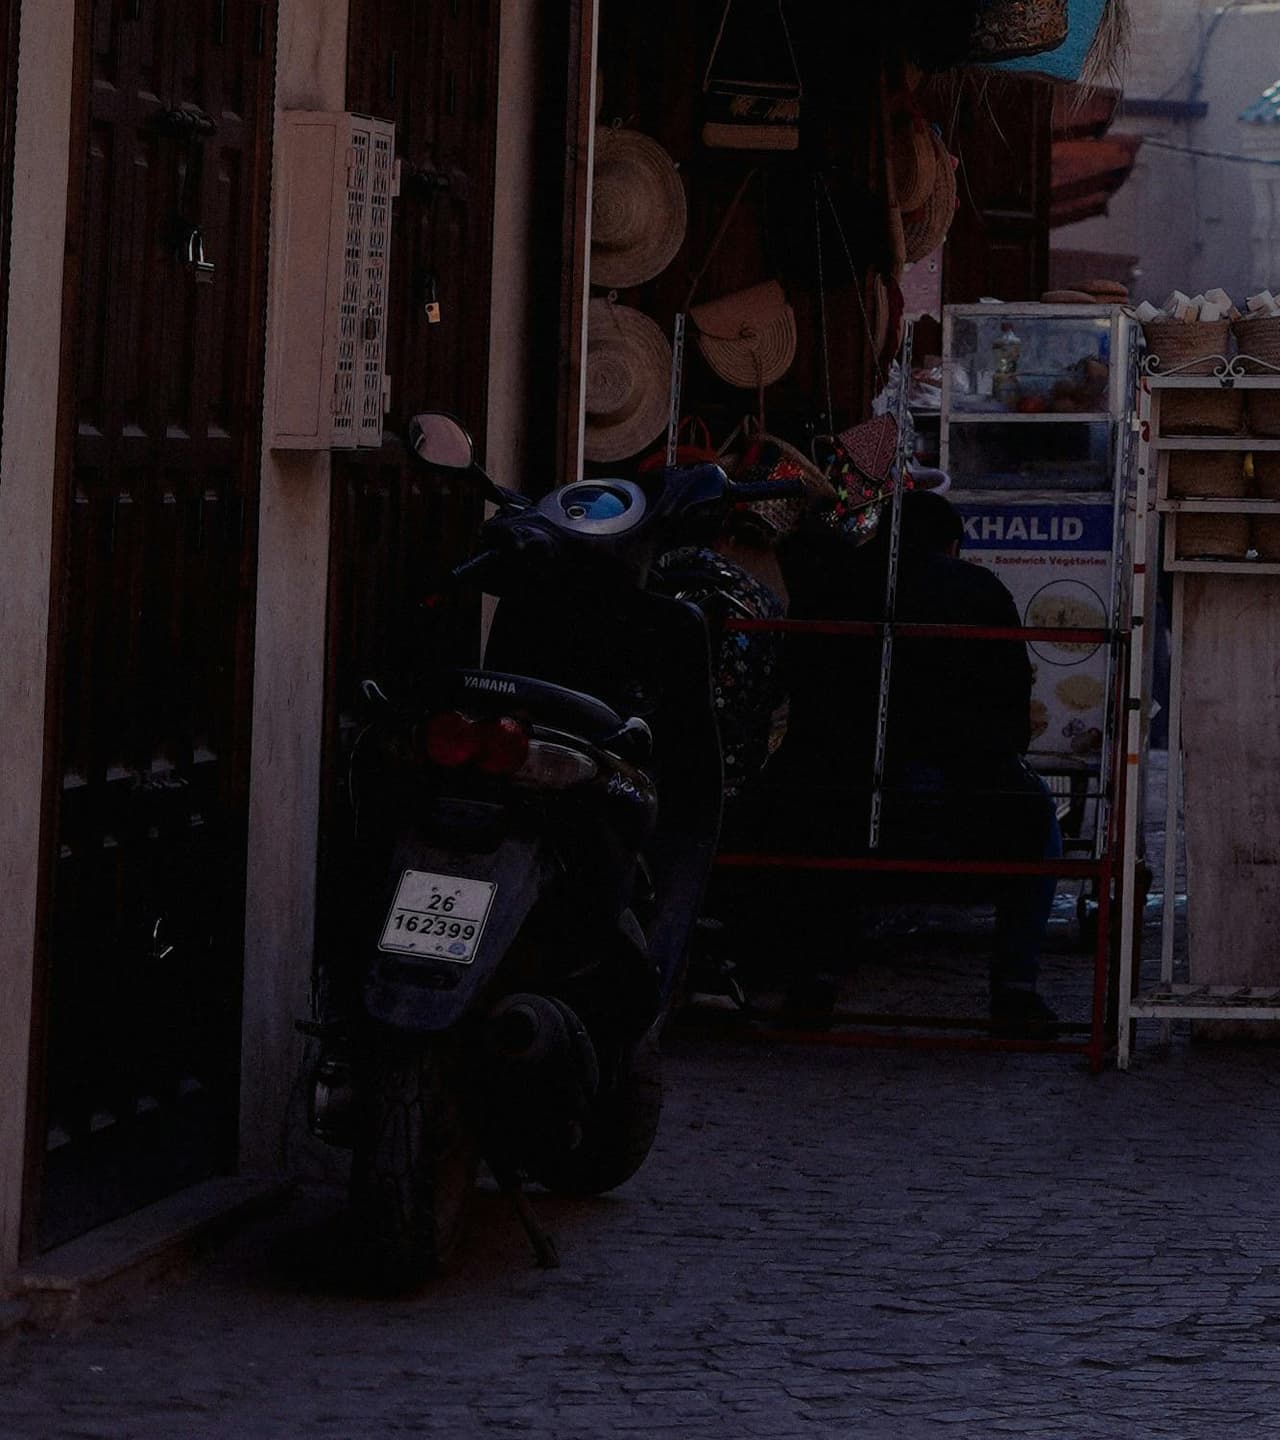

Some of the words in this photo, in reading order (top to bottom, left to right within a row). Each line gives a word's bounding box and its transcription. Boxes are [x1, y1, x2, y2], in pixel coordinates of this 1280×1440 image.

[960, 516, 1084, 542] KHALID
[995, 555, 1046, 565] Sandwich
[464, 675, 517, 694] YAMAHA
[428, 894, 456, 912] 26
[395, 914, 475, 940] 162399
